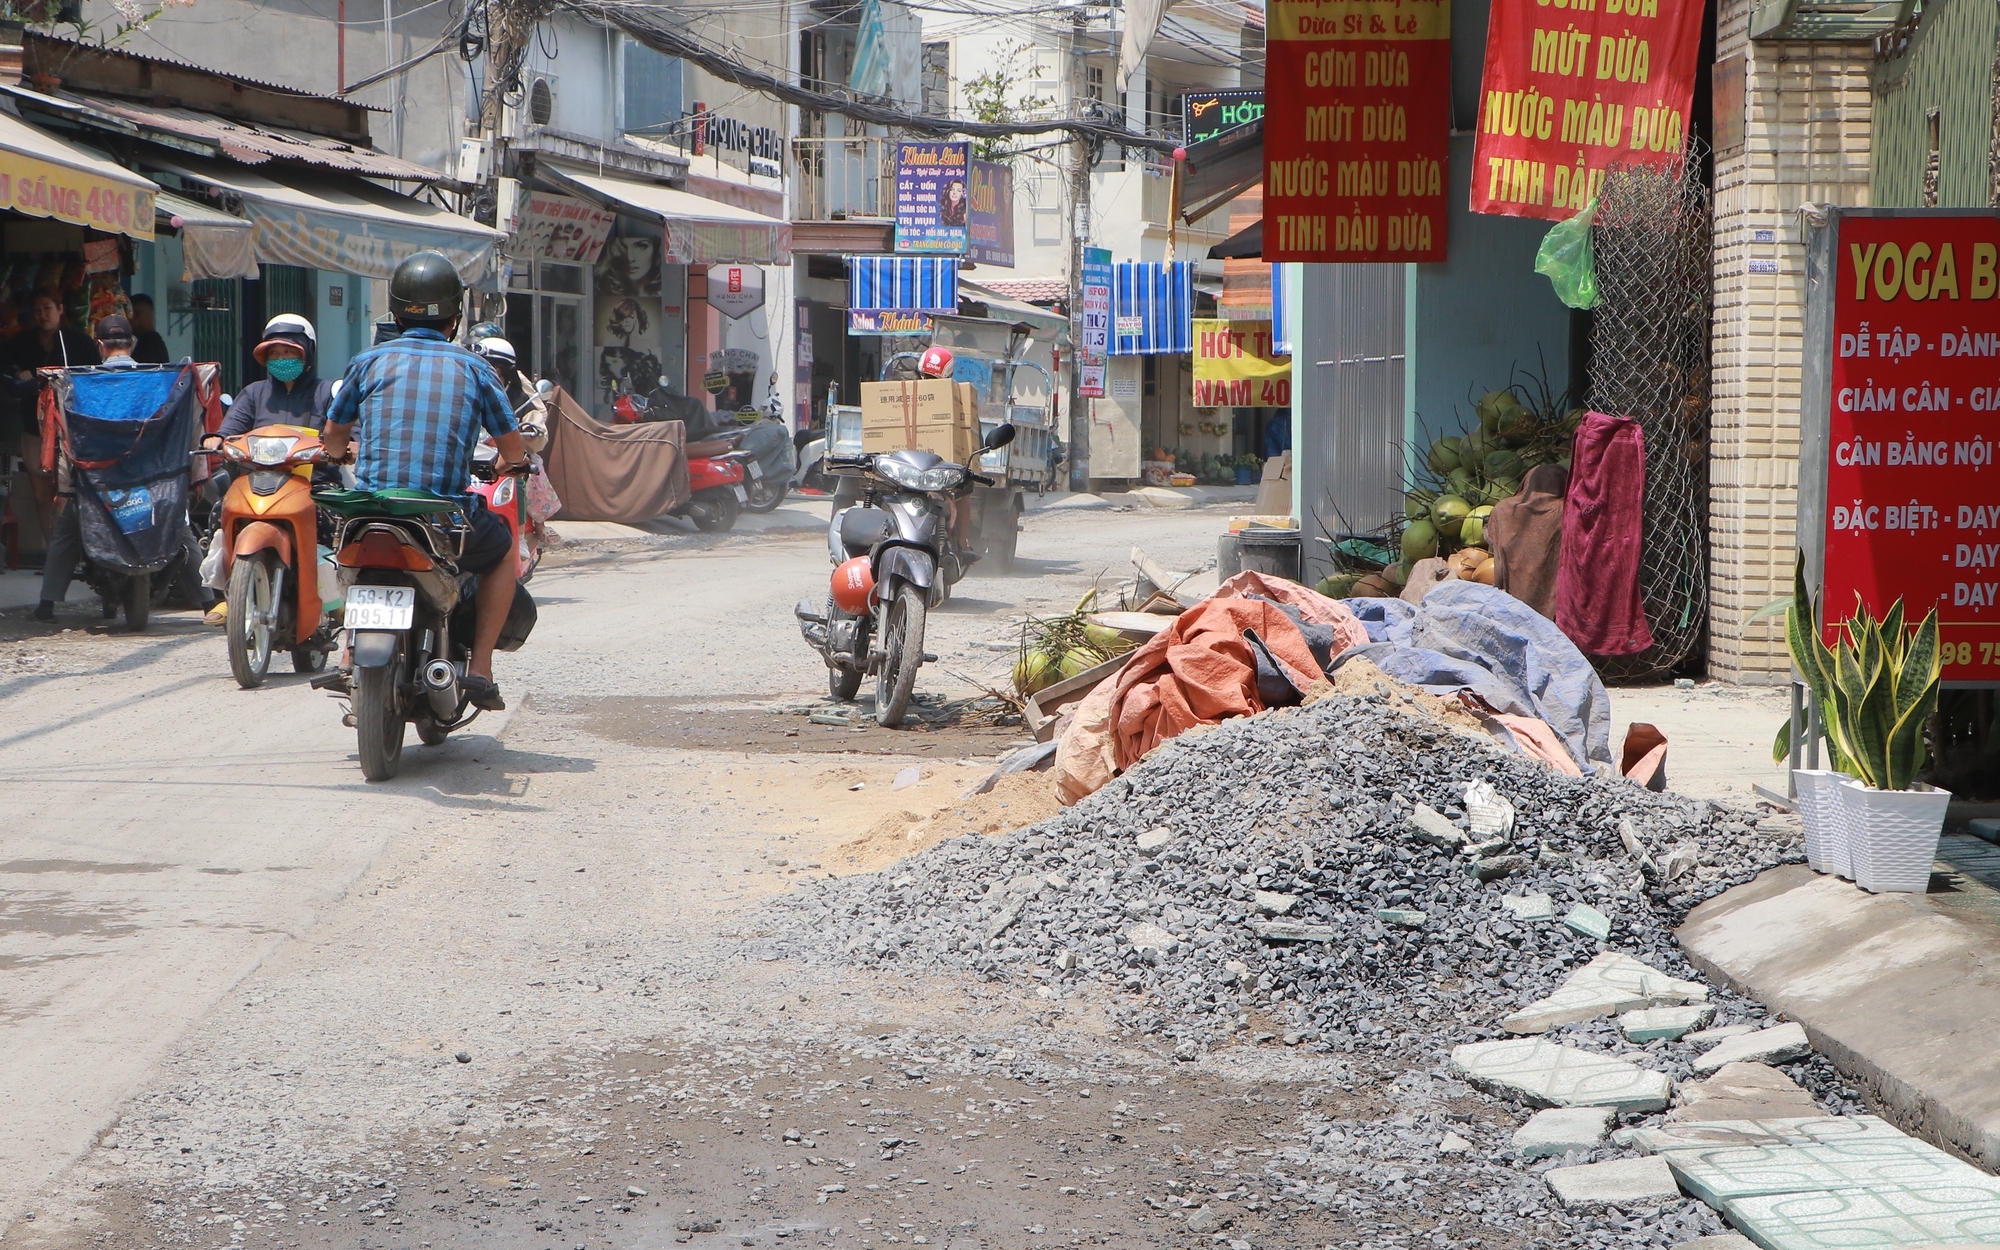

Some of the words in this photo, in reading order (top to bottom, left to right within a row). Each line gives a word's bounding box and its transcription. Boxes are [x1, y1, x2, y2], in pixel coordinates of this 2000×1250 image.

[1298, 15, 1337, 35] Dừa
[1343, 14, 1363, 34] Sỉ
[1369, 15, 1387, 34] &
[1394, 14, 1418, 34] Lẻ
[1305, 48, 1356, 87] CƠM
[1365, 44, 1410, 87] DỪA
[1531, 23, 1592, 77] MỨT
[1596, 29, 1649, 84] DỪA
[1221, 100, 1265, 124] HỚT
[1305, 98, 1355, 142] MỨT
[1362, 98, 1407, 142] DỪA
[1483, 85, 1554, 141] NƯỚC
[1560, 92, 1624, 148] MÀU
[1629, 99, 1682, 154] DỪA
[752, 125, 780, 162] CHA
[900, 146, 938, 166] Khánh
[939, 146, 965, 166] Linh
[920, 180, 937, 190] UỐN
[1269, 153, 1329, 197] NƯỚC
[1337, 153, 1389, 197] MÀU
[1397, 153, 1441, 197] DỪA
[1488, 157, 1546, 206] TINH
[17, 175, 81, 218] SÁNG
[85, 186, 130, 227] 486
[916, 204, 927, 214] SÓC
[899, 217, 912, 226] TRỊ
[914, 217, 936, 227] MỤN
[1277, 215, 1327, 251] TINH
[1335, 201, 1379, 251] DẦU
[1388, 208, 1432, 251] DỪA
[1850, 241, 1959, 301] YOGA
[1970, 242, 2000, 300] B
[852, 313, 875, 330] Salon
[877, 311, 922, 332] Khánh
[1086, 311, 1100, 328] THỨ
[1101, 316, 1107, 328] 7
[1201, 326, 1246, 359] HỚT
[1840, 321, 1870, 358] DỄ
[1877, 326, 1921, 364] TẬP
[1941, 326, 2000, 357] DÀNH
[1195, 379, 1252, 407] NAM
[1261, 379, 1290, 406] 40
[1838, 378, 1896, 413] GIẢM
[1902, 381, 1950, 412] CÂN
[1836, 435, 1881, 467] CÂN
[1887, 430, 1948, 466] BẰNG
[1954, 434, 1992, 473] NỘI
[1833, 499, 1879, 537] ĐẶC
[1885, 499, 1938, 537] BIỆT:
[1958, 506, 2000, 536] DẠY
[1956, 544, 2000, 575] DẠY
[357, 589, 404, 607] 59-K2
[1954, 582, 1999, 613] DẠY
[348, 608, 407, 627] 095.11
